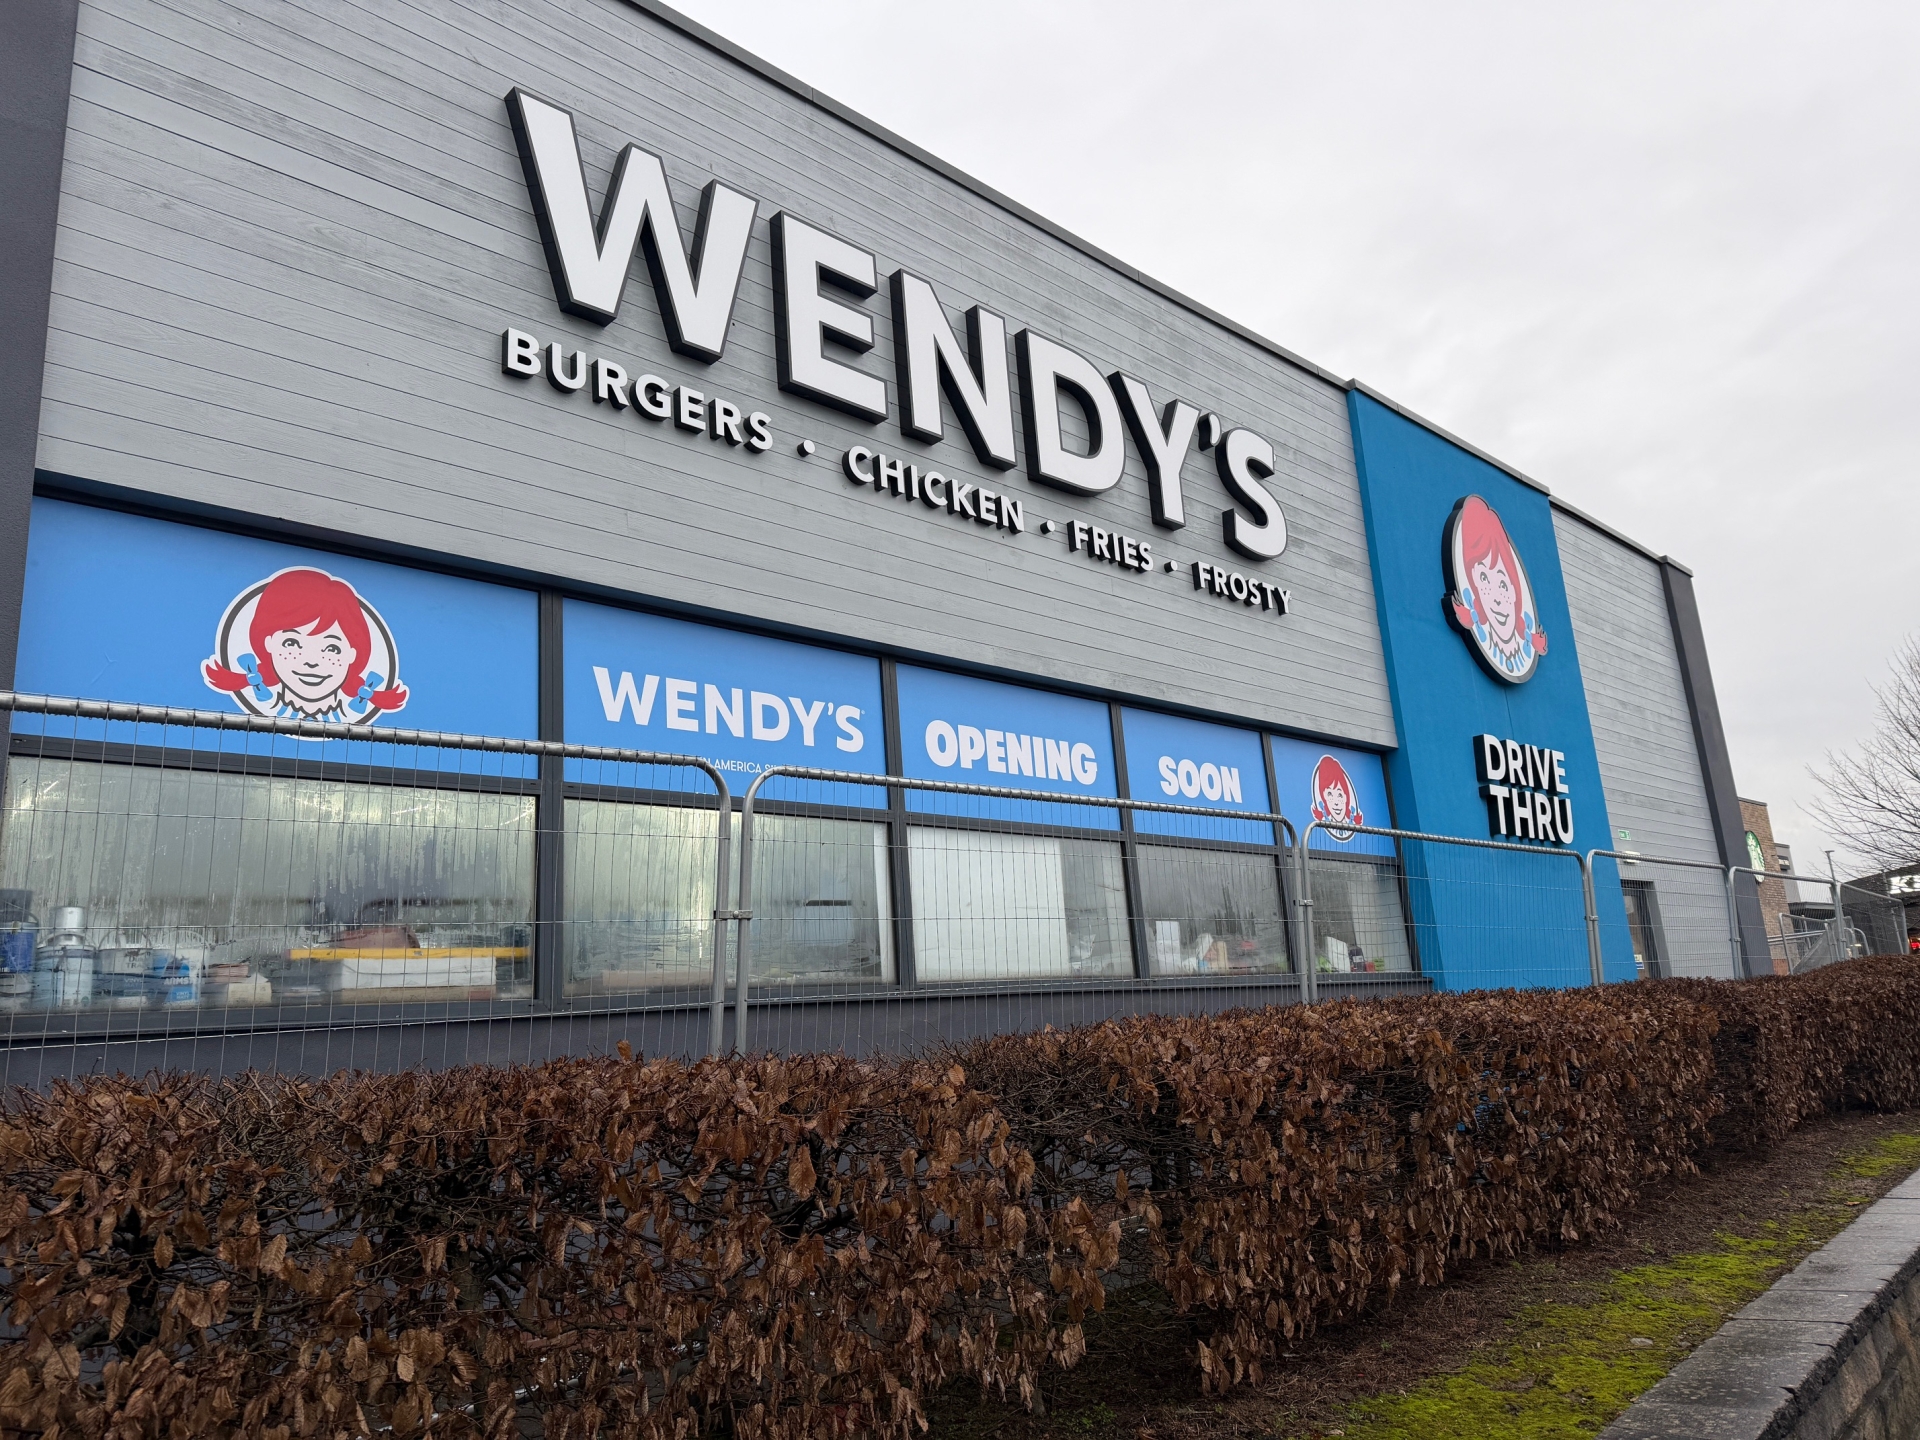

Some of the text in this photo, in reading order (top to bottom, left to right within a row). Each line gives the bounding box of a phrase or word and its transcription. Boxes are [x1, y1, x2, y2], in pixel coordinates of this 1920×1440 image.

[506, 86, 1289, 560] WENDY'S
[503, 327, 1292, 615] BURGERS CHICKEN FRIES FROSTY
[592, 666, 865, 753] WENDY'S
[714, 758, 762, 774] AMERICA
[925, 719, 1243, 804] OPENING SOON
[1475, 733, 1570, 794] DRIVE
[1480, 783, 1575, 845] THRU
